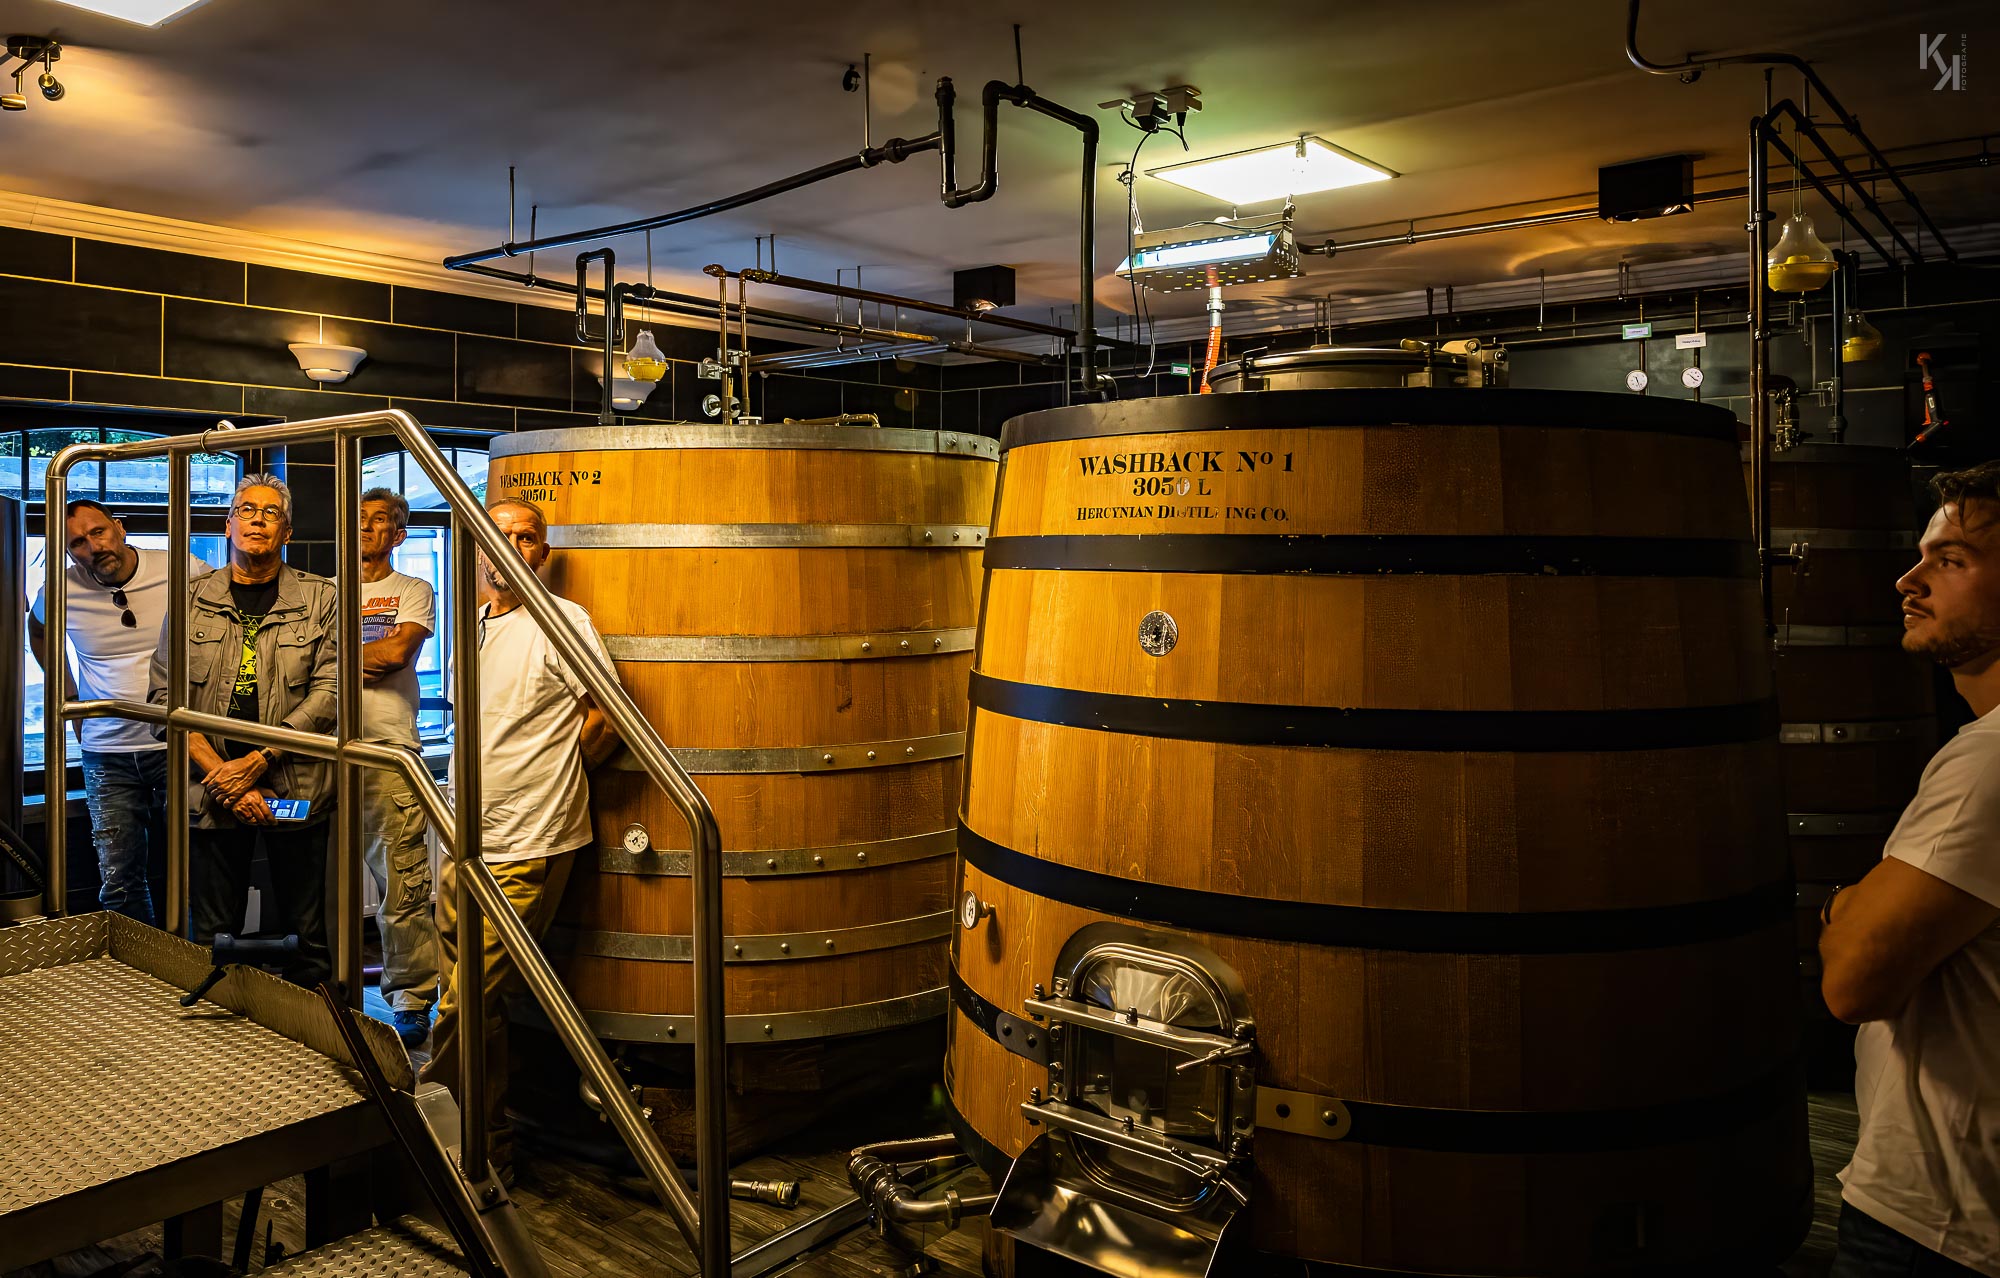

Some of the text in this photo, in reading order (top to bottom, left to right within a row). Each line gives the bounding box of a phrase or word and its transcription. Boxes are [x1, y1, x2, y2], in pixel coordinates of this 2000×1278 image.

[1079, 451, 1224, 476] WASHBACK
[1282, 452, 1294, 472] 1
[500, 471, 563, 488] WASHBACK
[592, 470, 601, 485] 2
[1133, 476, 1211, 496] 3050 L
[520, 489, 557, 502] 3050 L
[1076, 506, 1154, 520] HERCYNIAN
